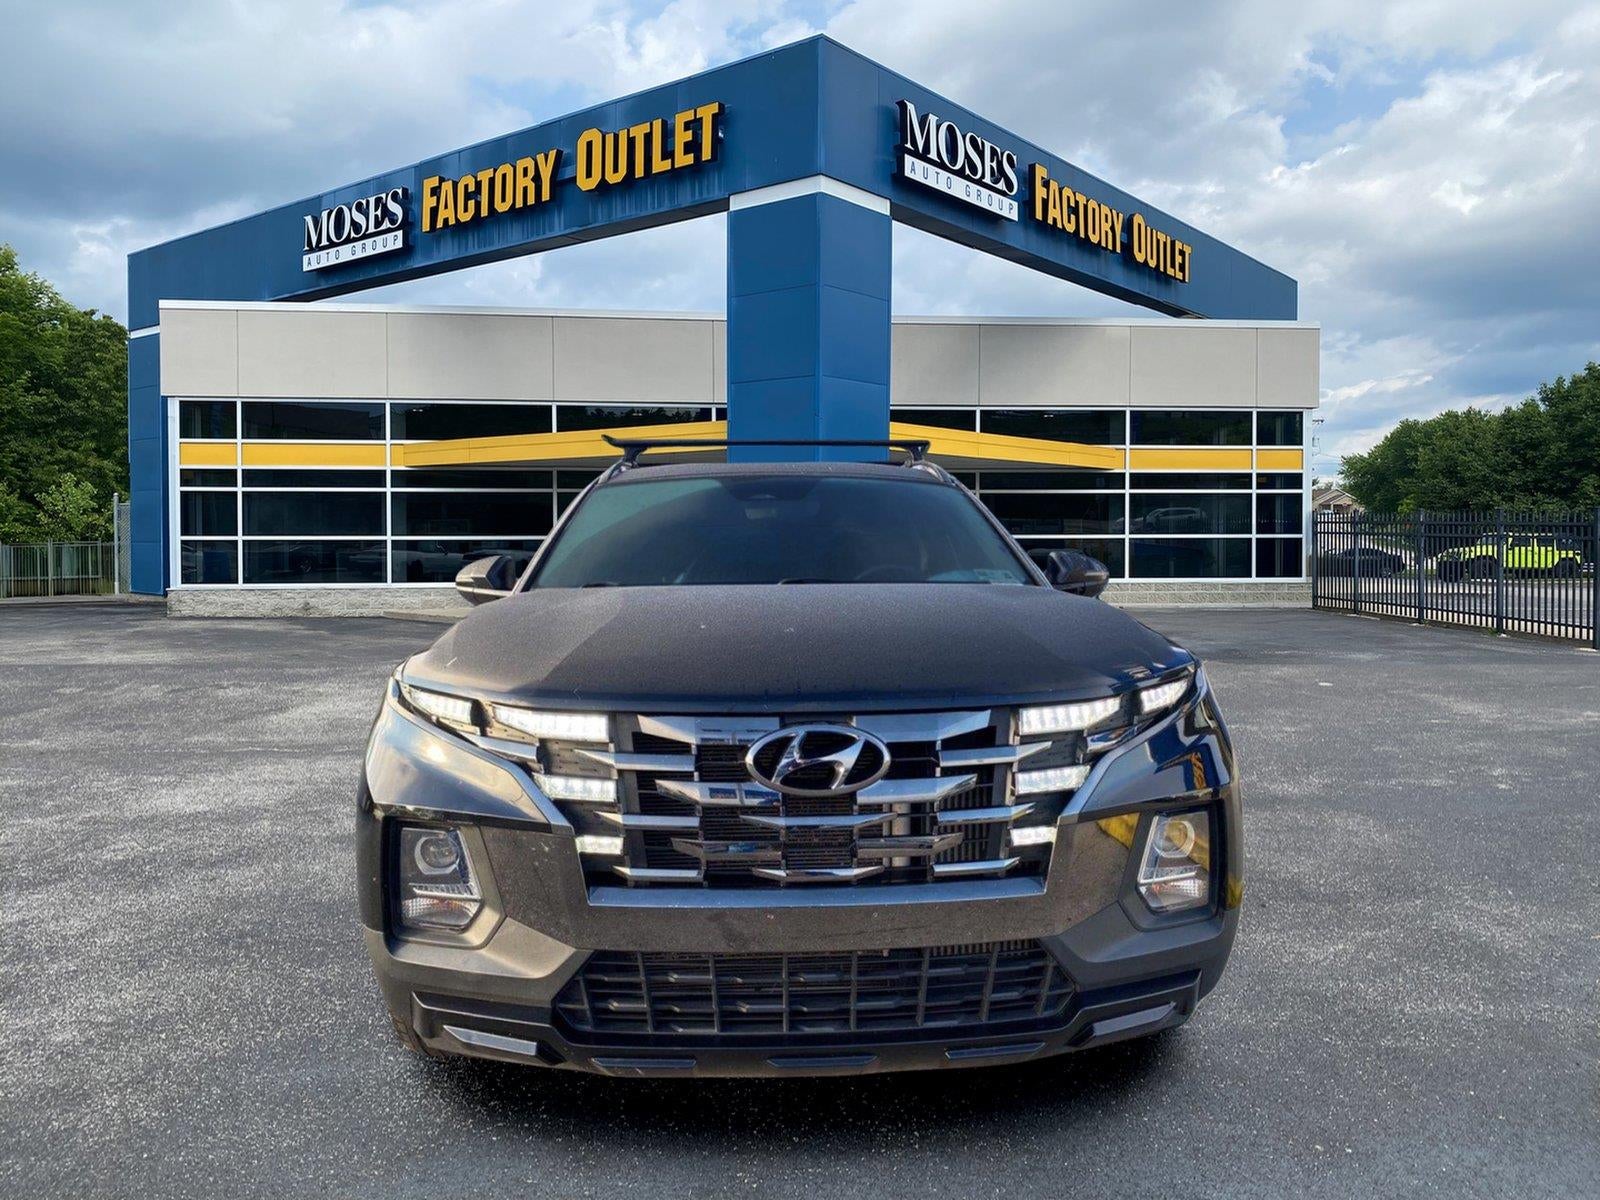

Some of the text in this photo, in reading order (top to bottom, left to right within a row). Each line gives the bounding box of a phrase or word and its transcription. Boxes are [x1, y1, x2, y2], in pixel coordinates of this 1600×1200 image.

[422, 102, 720, 233] FACTORY OUTLET
[904, 100, 1018, 195] MOSES
[303, 188, 404, 251] MOSES
[909, 161, 1015, 215] AUTO GROUP
[1034, 163, 1192, 282] FACTORY OUTLET
[307, 233, 400, 268] AUTO GROUP
